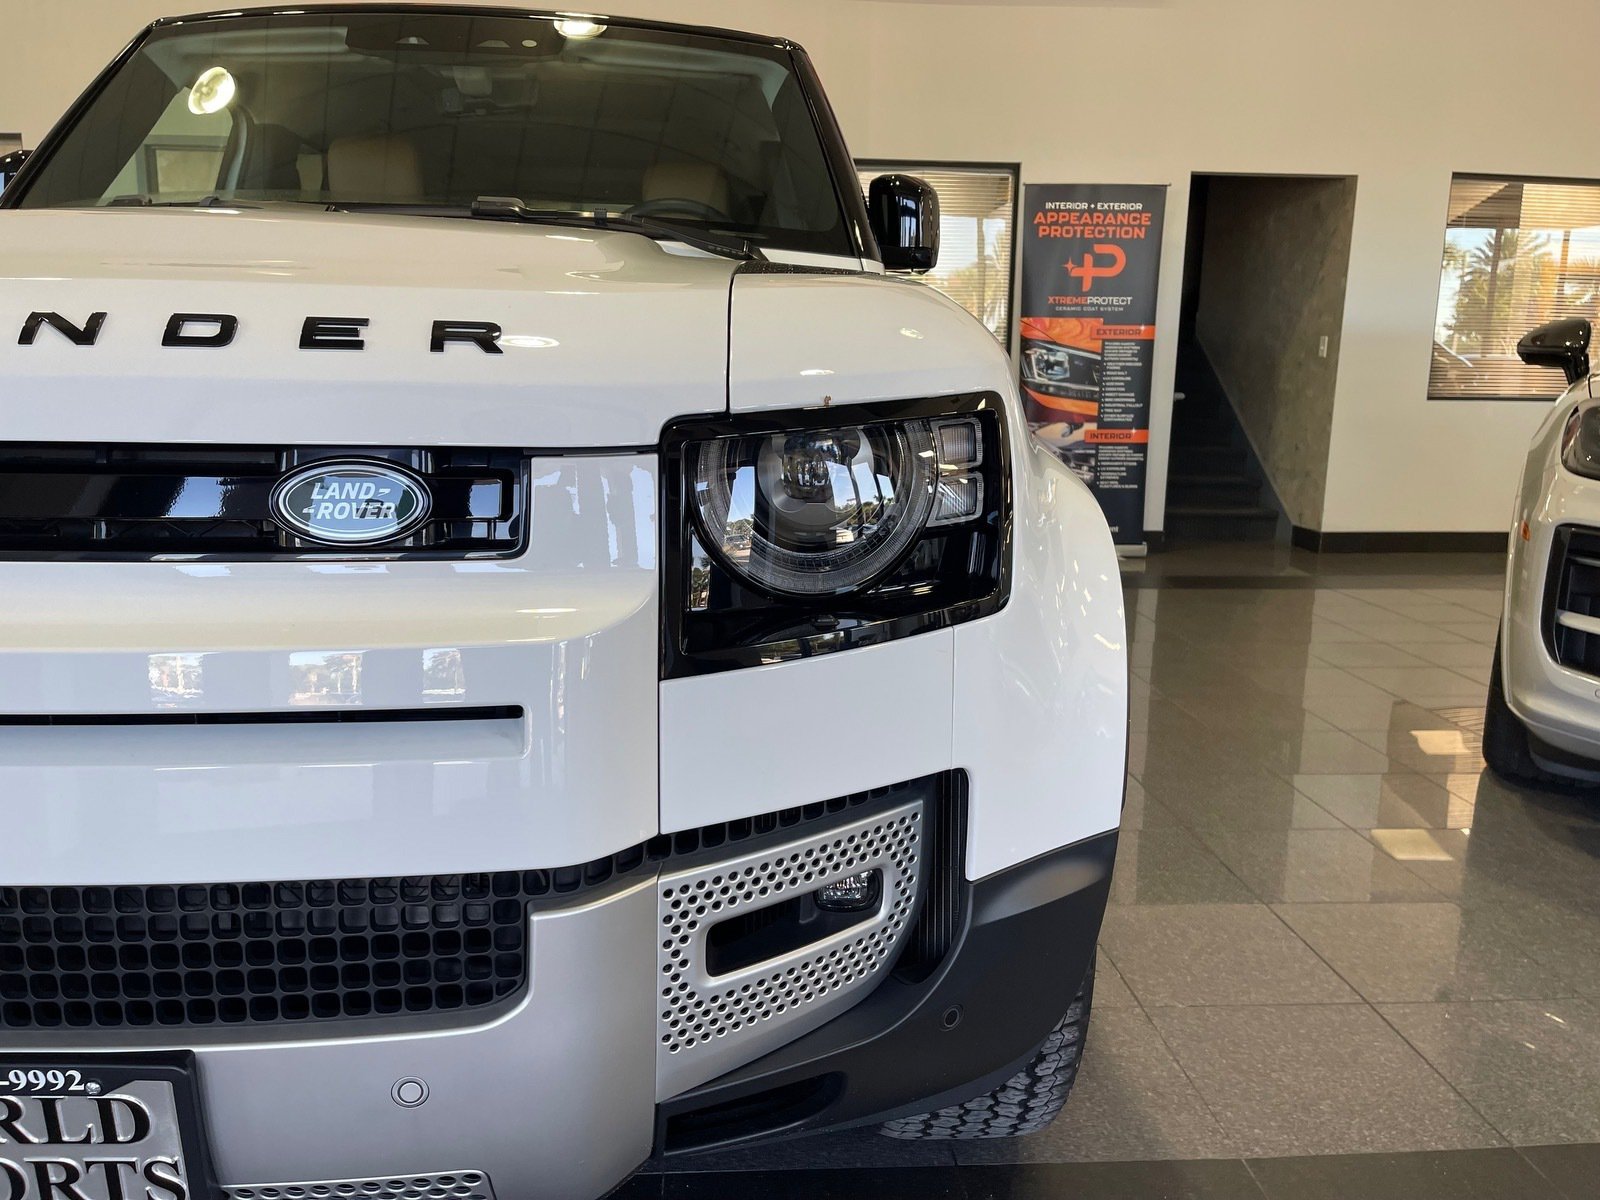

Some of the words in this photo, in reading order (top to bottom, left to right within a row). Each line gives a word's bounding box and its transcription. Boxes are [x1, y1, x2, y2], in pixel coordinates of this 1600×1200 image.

[1045, 202, 1088, 210] INTERIOR
[1097, 202, 1143, 211] EXTERIOR
[1033, 212, 1152, 225] APPEARANCE
[1038, 225, 1146, 239] PROTECTION
[1048, 296, 1133, 305] XTREMEPROTECT
[17, 310, 504, 355] NDER
[310, 482, 376, 500] LAND
[316, 502, 396, 520] ROVER
